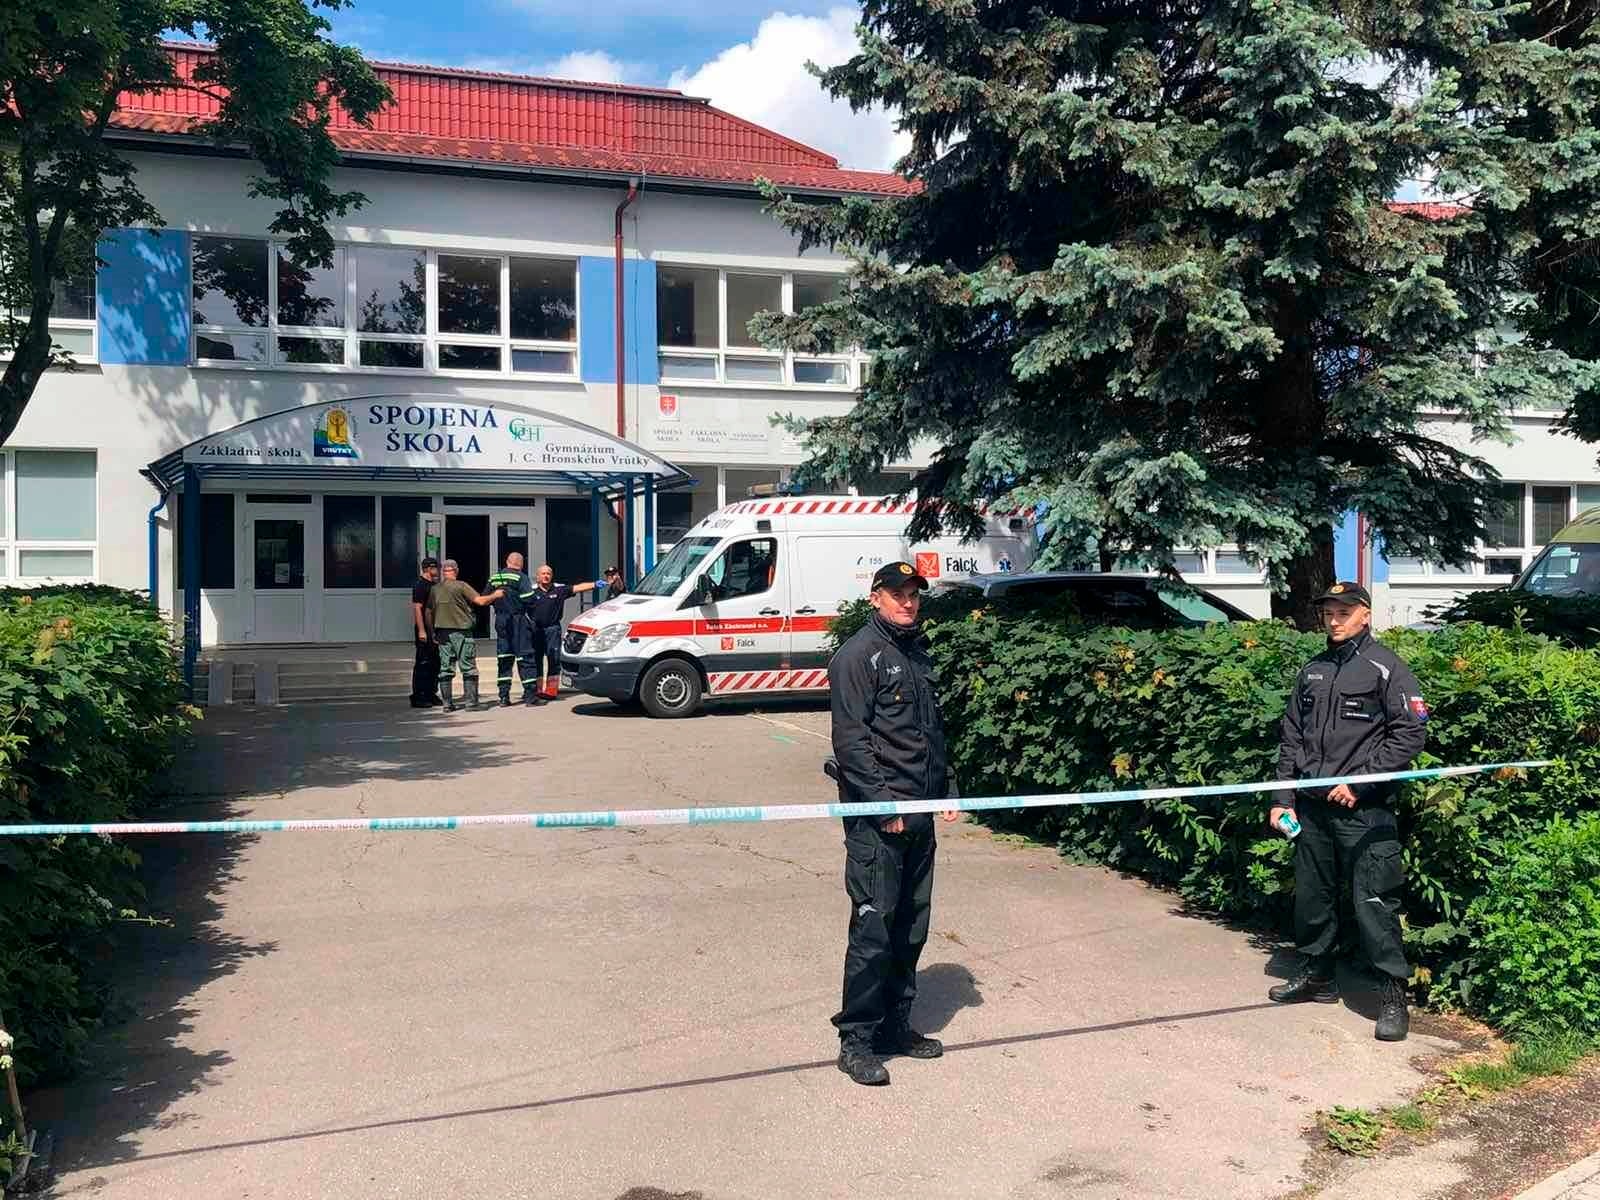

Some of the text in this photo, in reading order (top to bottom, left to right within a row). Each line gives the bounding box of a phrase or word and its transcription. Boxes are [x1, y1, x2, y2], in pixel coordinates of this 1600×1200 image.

[368, 404, 498, 430] SPOJENÁ
[386, 423, 482, 453] ŠKOLA
[199, 445, 302, 457] Základná škola
[545, 442, 615, 455] Gymnázium
[542, 453, 606, 465] Hronského
[611, 454, 649, 467] Vrútky
[869, 557, 883, 565] 155
[945, 556, 978, 572] Falck
[736, 638, 756, 648] Falck
